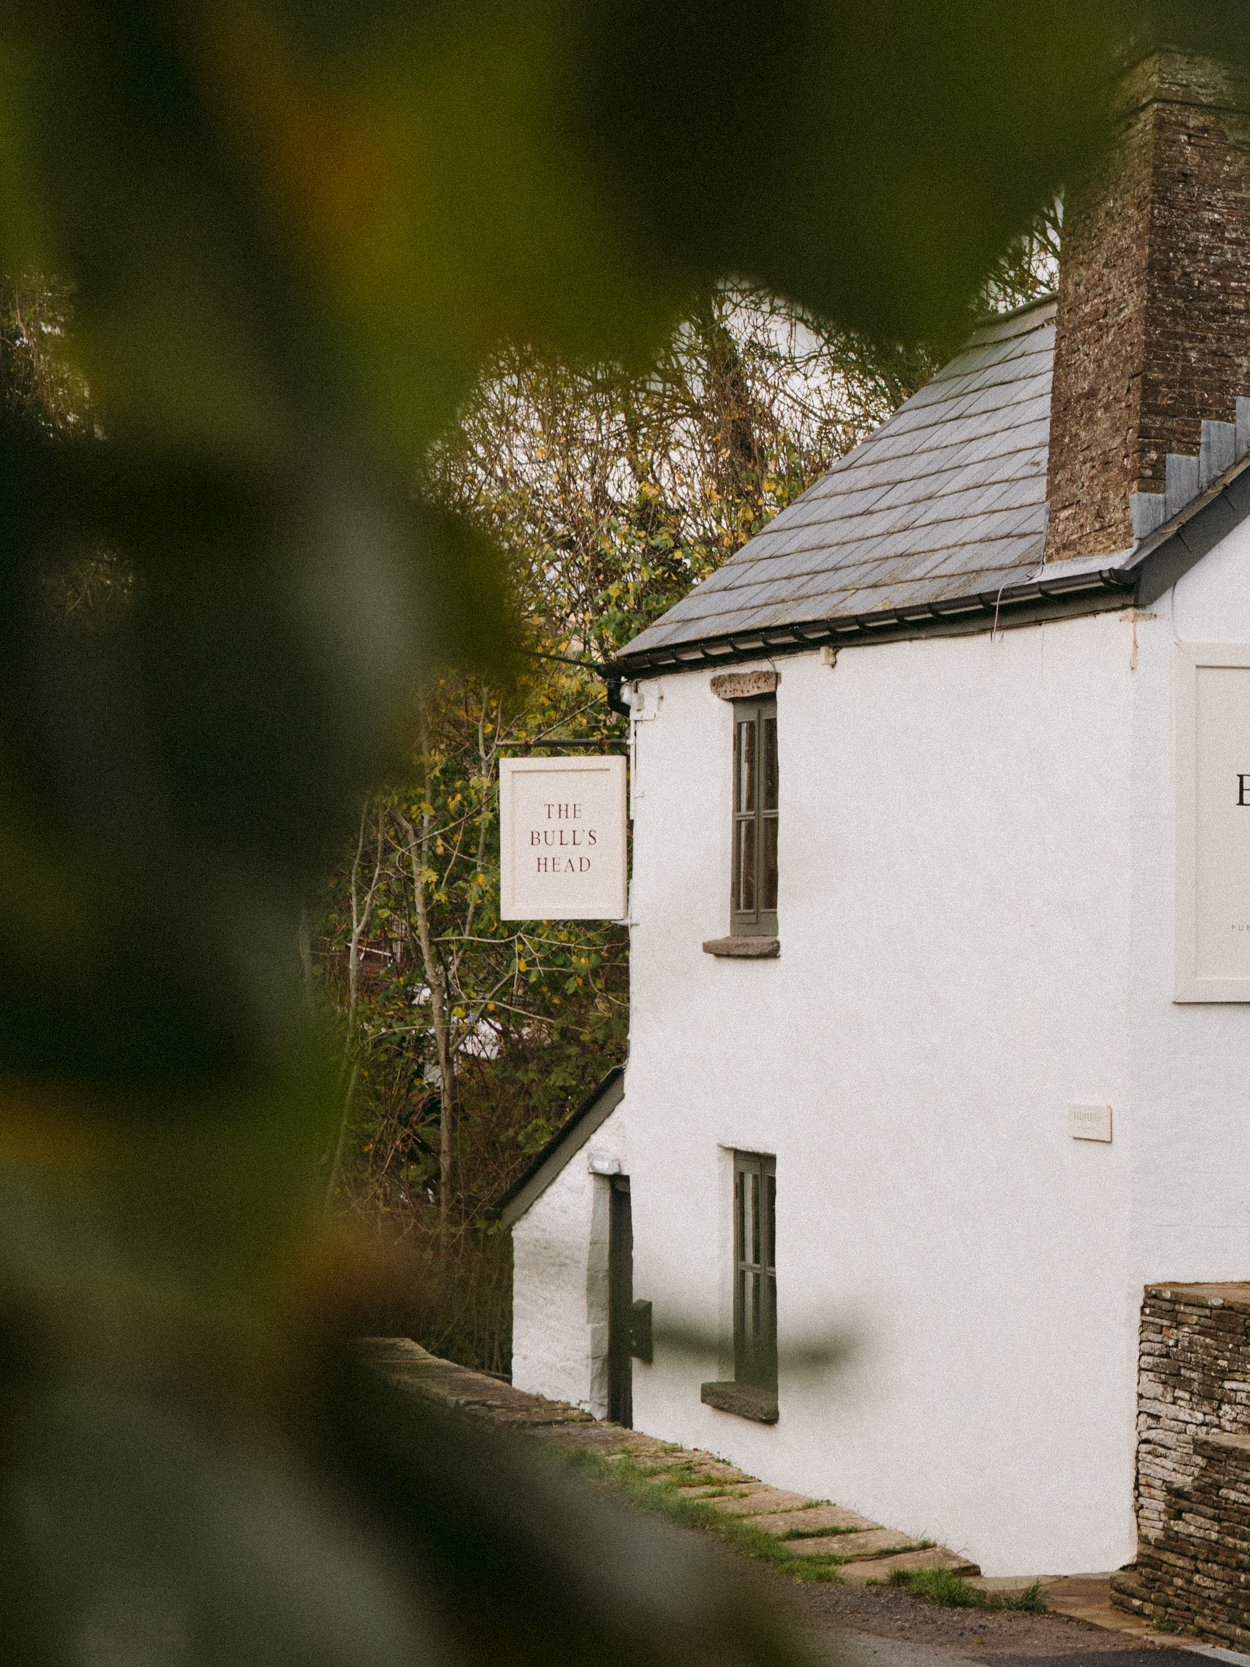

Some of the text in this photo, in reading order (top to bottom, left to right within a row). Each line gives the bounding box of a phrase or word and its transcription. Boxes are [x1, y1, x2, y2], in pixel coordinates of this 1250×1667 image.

[543, 803, 582, 820] THE
[530, 829, 597, 847] BULL'S
[536, 856, 592, 873] HEAD
